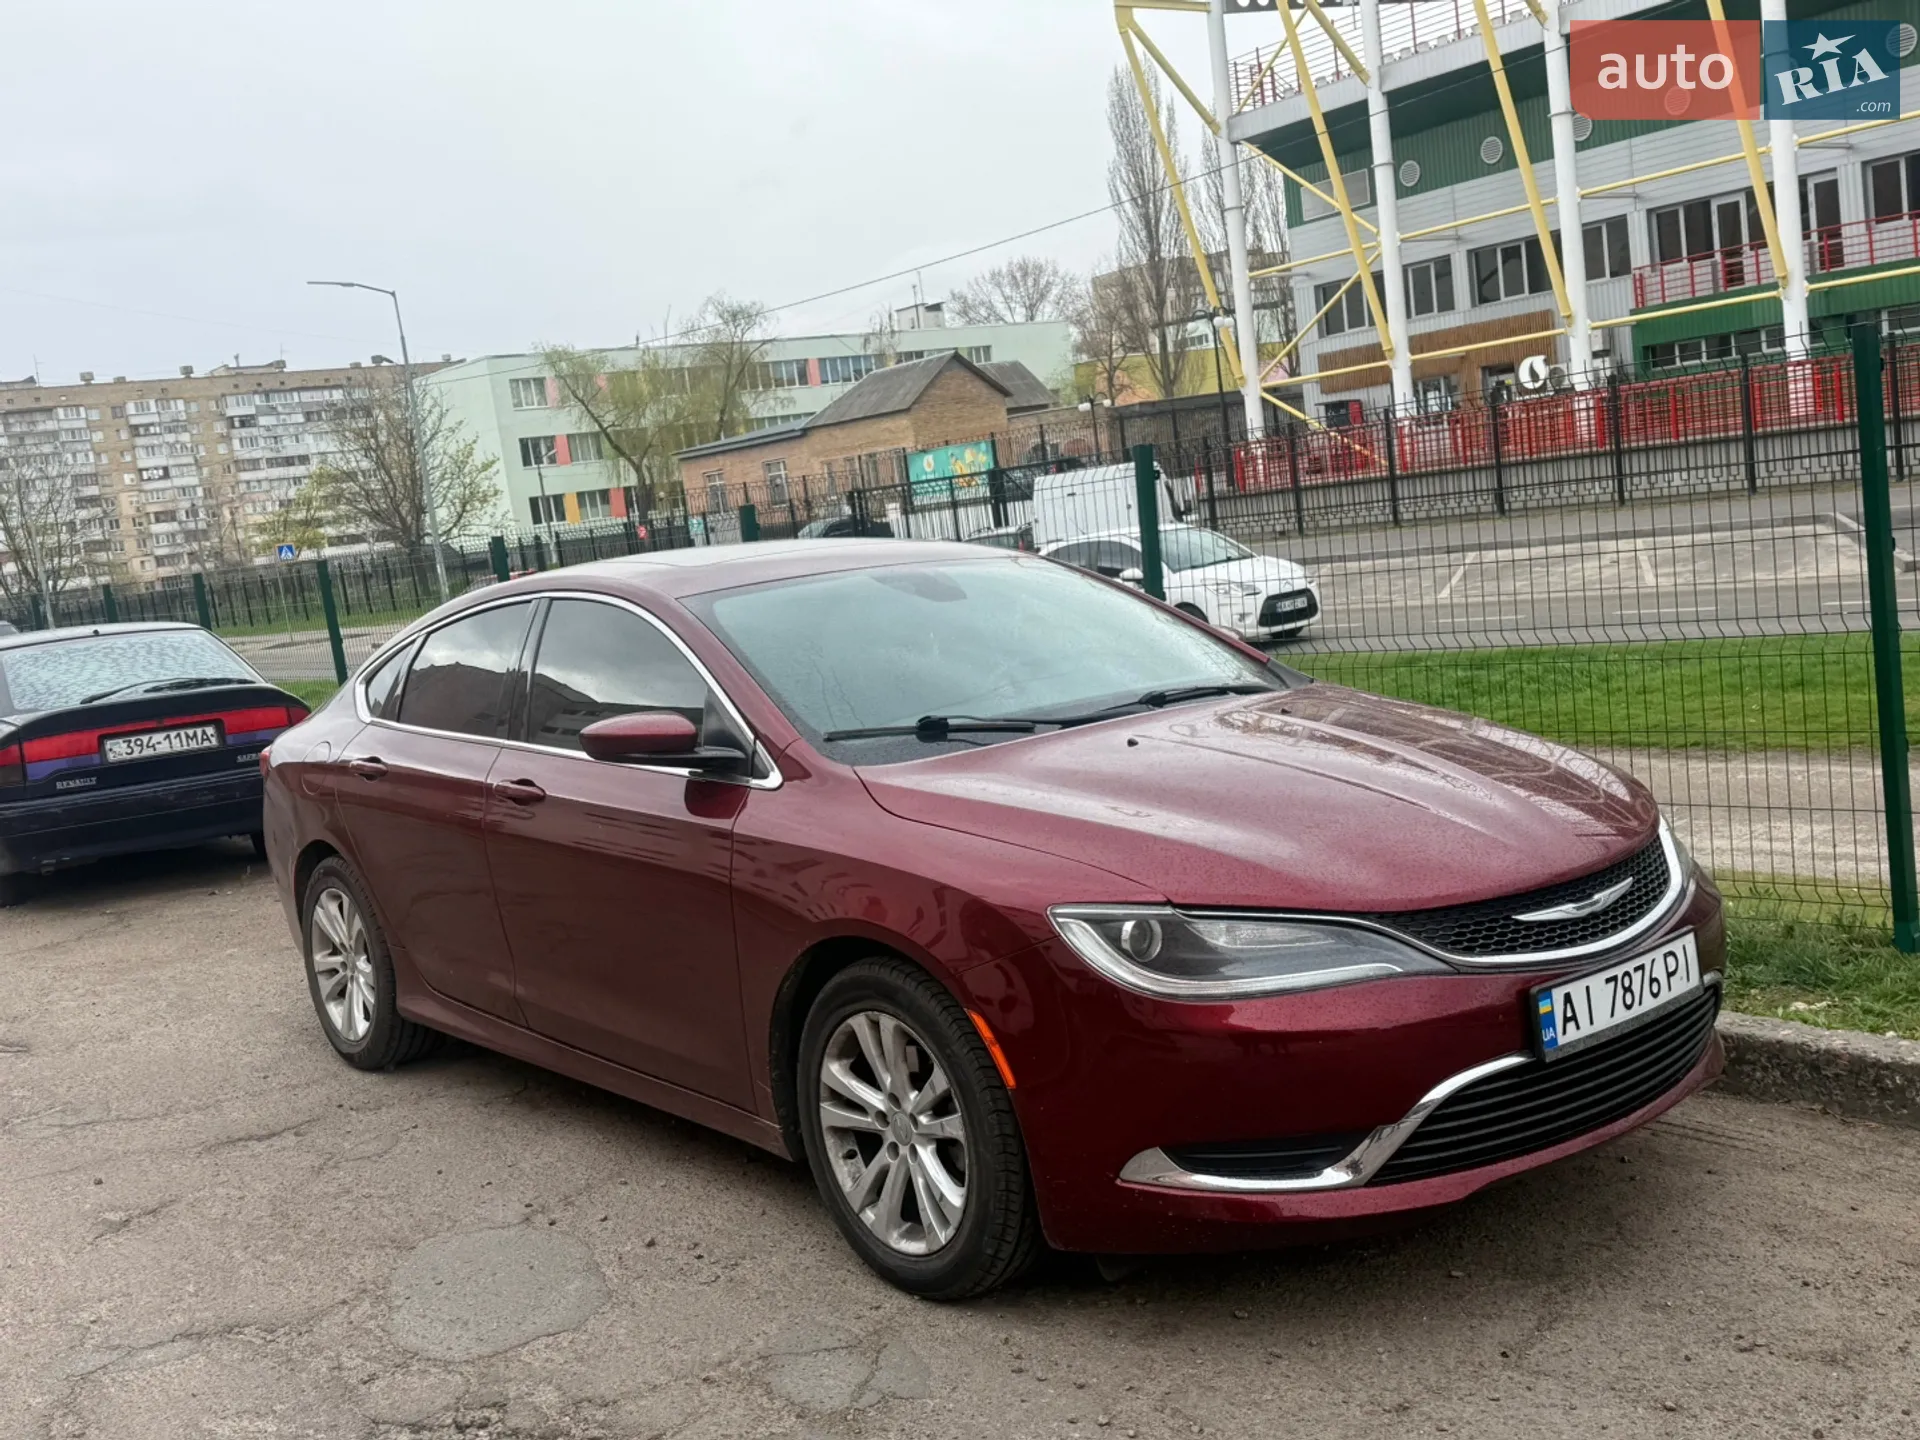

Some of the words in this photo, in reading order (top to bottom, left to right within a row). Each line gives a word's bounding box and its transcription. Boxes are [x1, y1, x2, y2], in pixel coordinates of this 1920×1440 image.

[56, 776, 97, 790] RENAULT
[1561, 984, 1595, 1036] AI
[1604, 957, 1662, 1019] 7876
[1663, 943, 1691, 993] PI
[1542, 1026, 1556, 1041] UA
